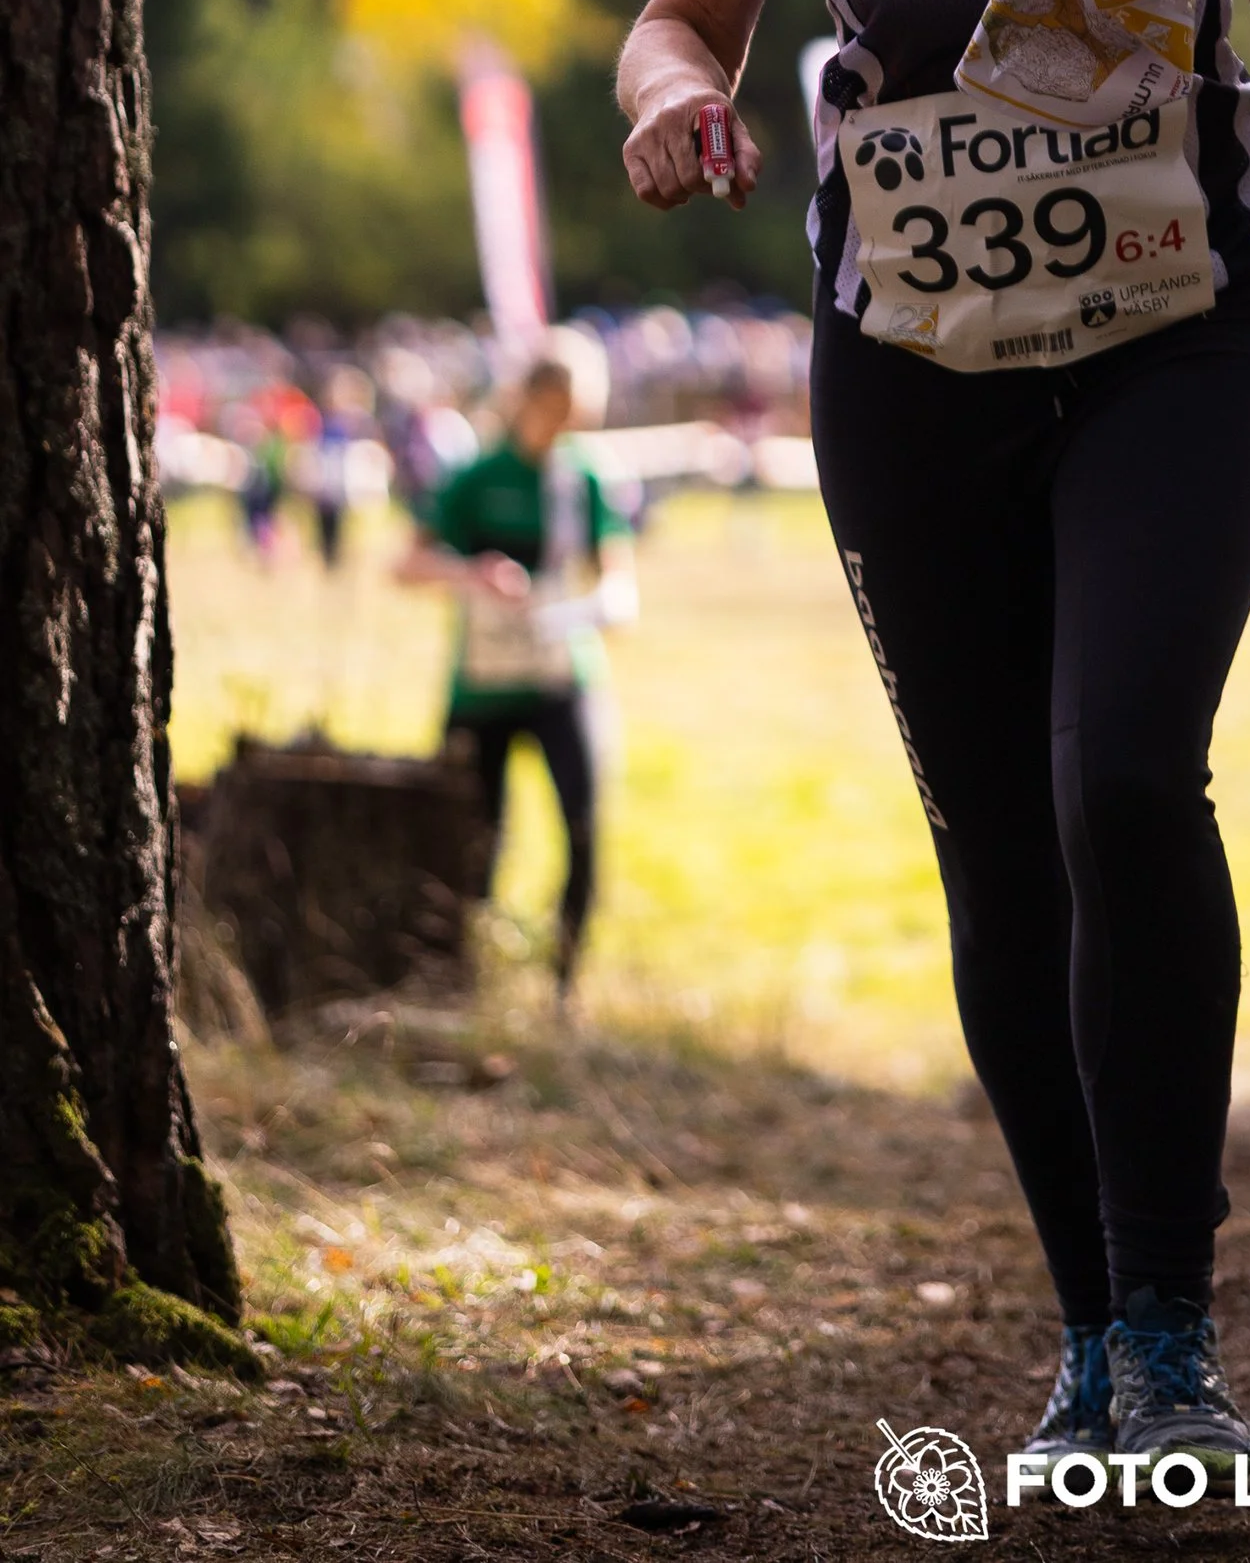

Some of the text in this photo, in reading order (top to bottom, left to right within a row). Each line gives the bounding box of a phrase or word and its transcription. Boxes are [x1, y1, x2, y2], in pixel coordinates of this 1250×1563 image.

[893, 187, 1106, 292] 339
[1115, 219, 1186, 262] 6:4
[1119, 272, 1201, 302] UPPLANDS
[896, 304, 935, 332] 25
[1123, 296, 1170, 317] VÄSBY
